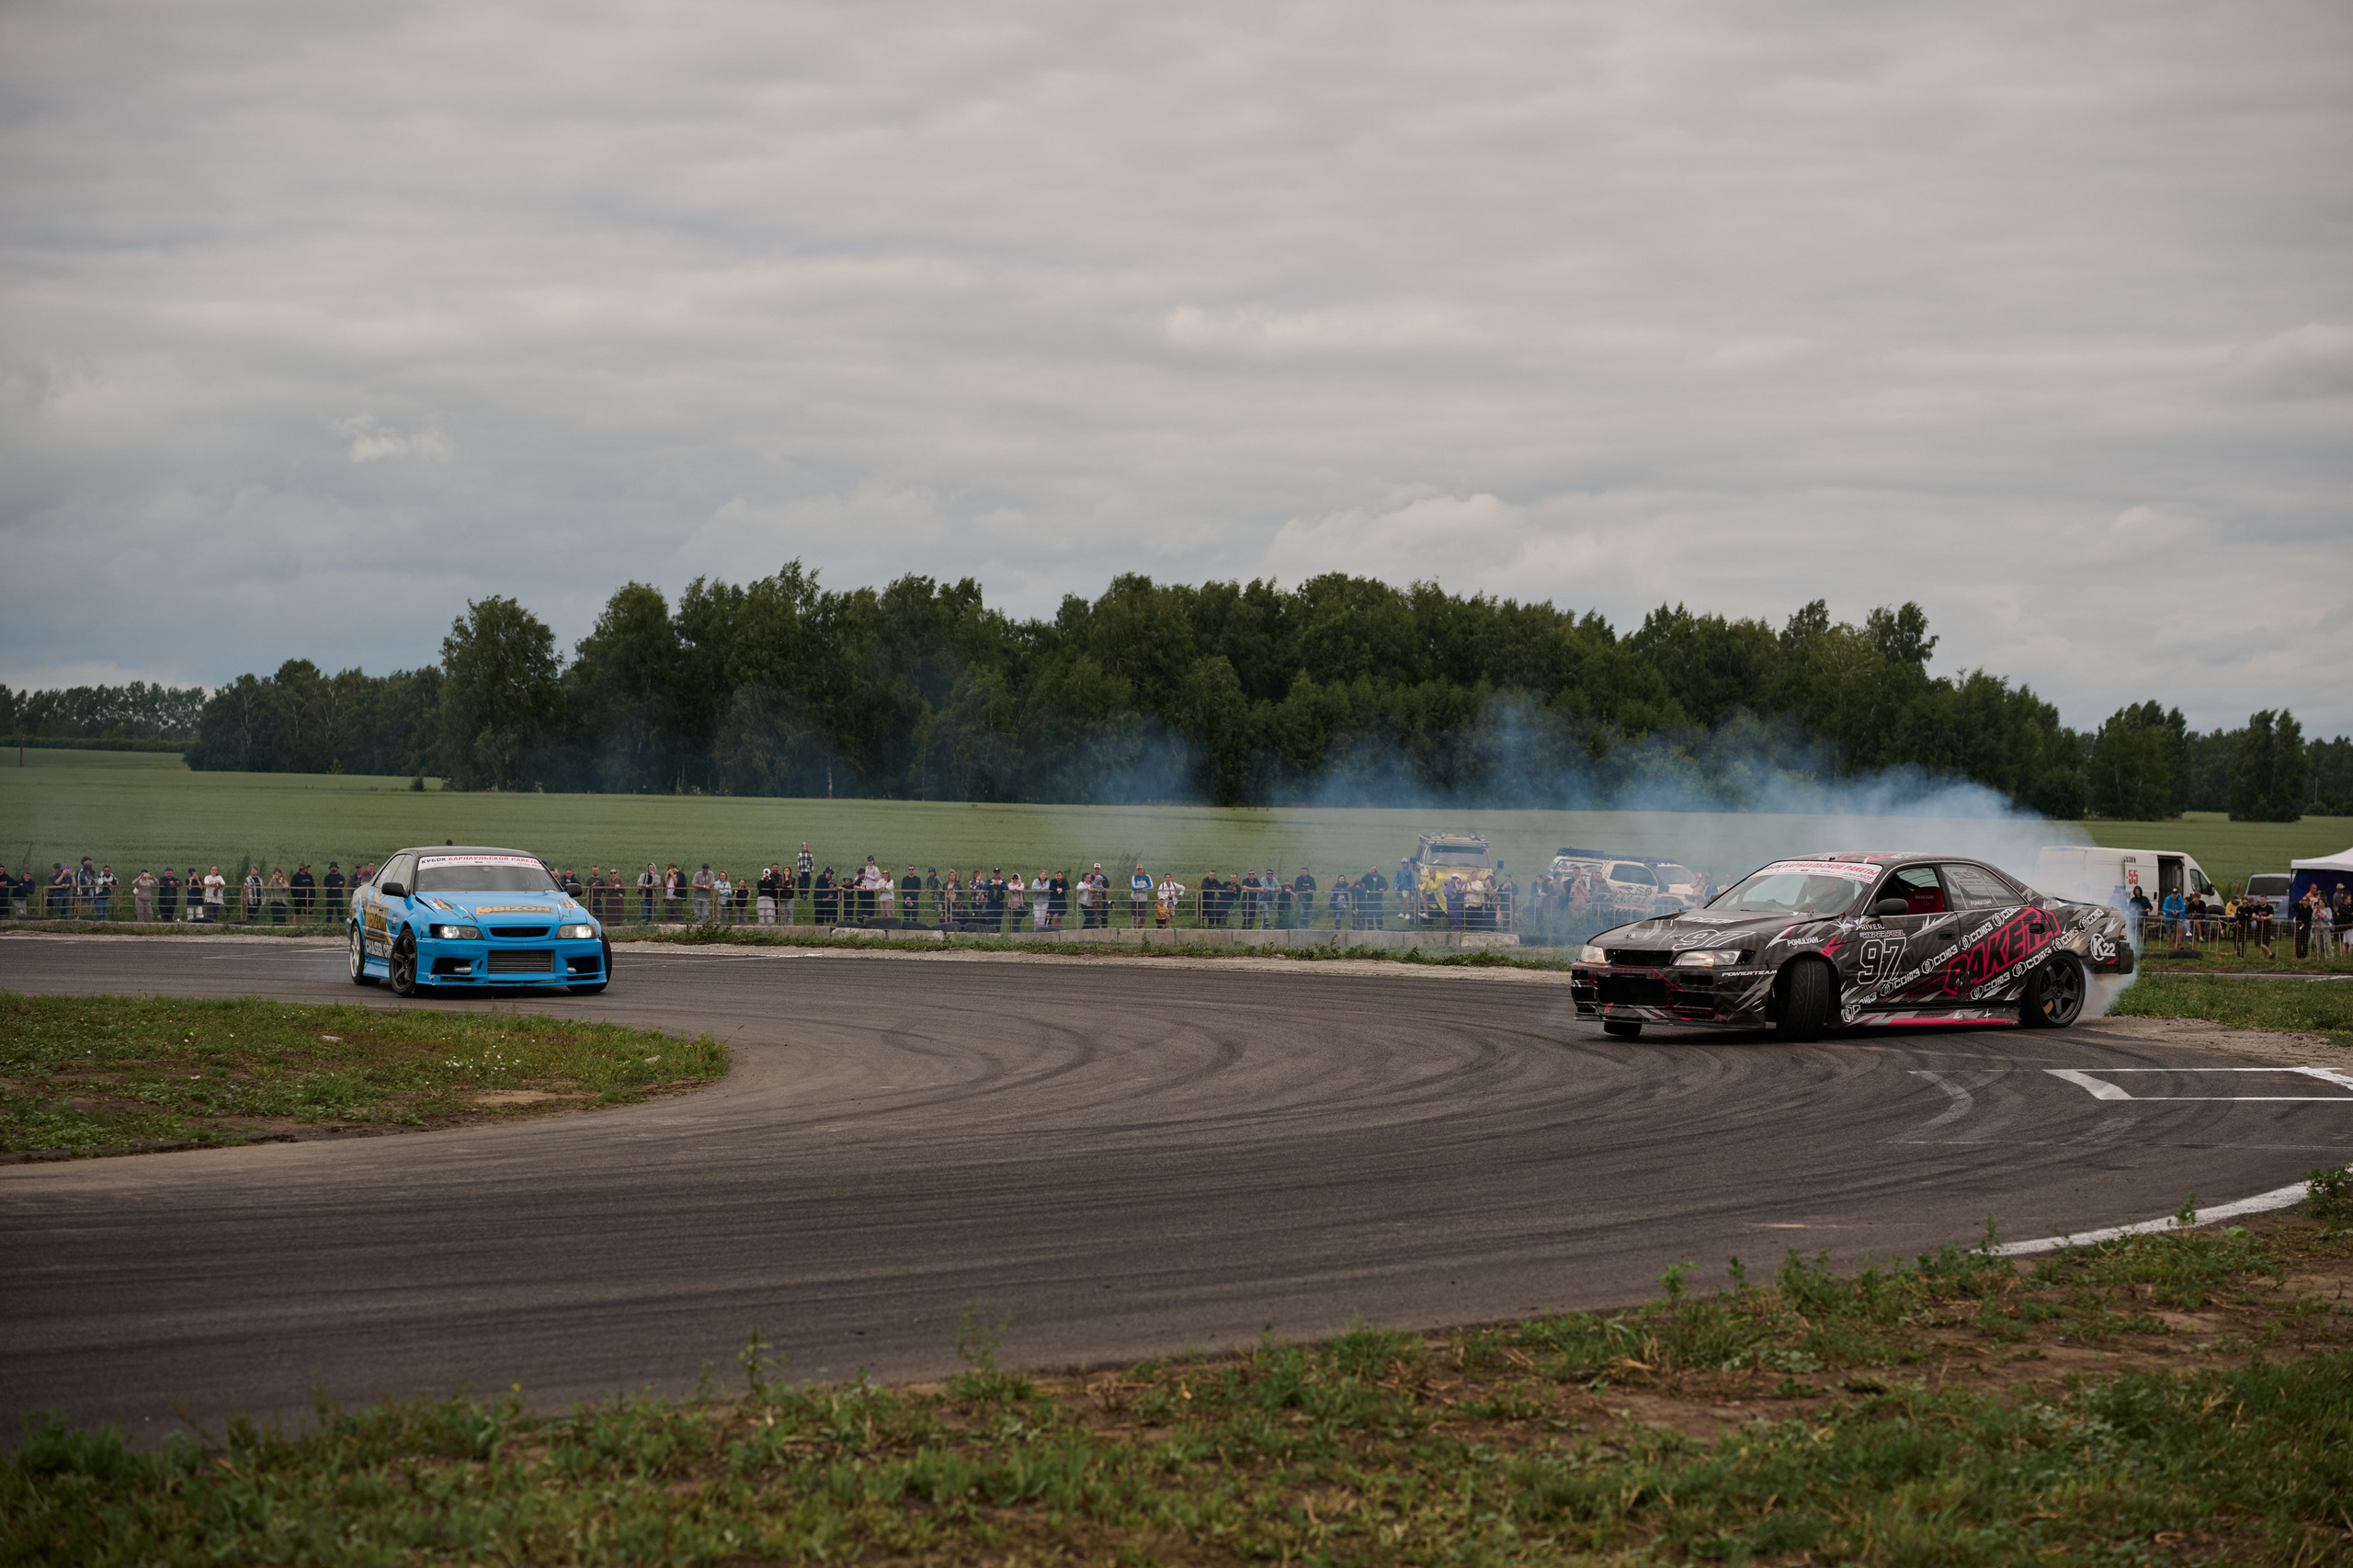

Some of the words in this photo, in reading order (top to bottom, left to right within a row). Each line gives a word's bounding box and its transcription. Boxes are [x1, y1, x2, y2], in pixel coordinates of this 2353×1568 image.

[1843, 865, 1879, 876] РАКЕТЫ
[1860, 923, 1885, 931] RIVER
[1970, 921, 1994, 943] СОЮЗ
[1671, 928, 1756, 950] 97
[1857, 937, 1907, 985] 97
[1933, 944, 1959, 966] СОЮЗ
[1942, 906, 2062, 995] РАКЕТА
[2026, 947, 2052, 970] СОЮЗ
[1893, 968, 1921, 989] СОЮЗ
[1984, 971, 2010, 993] СОЮЗ
